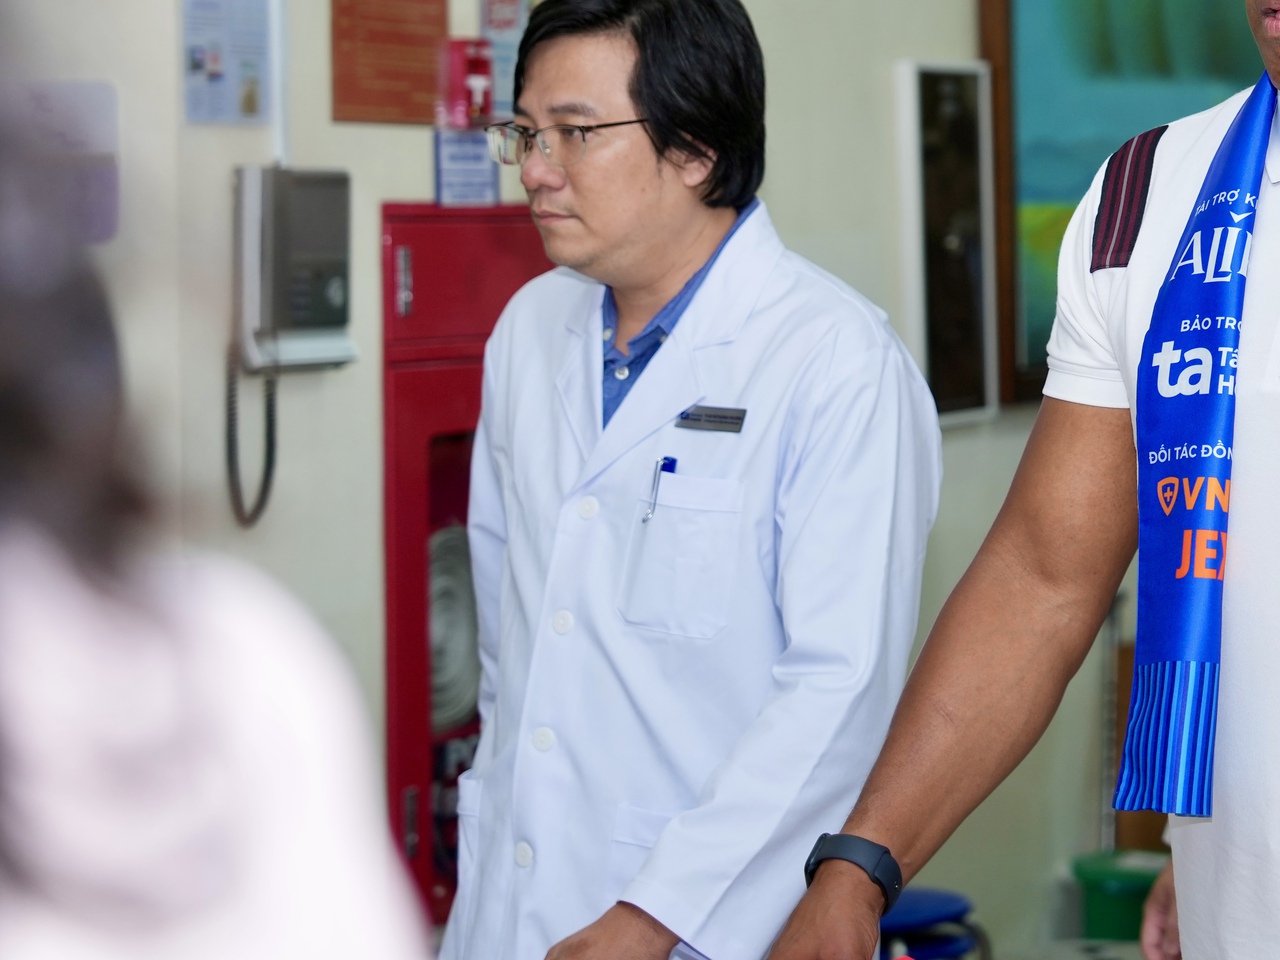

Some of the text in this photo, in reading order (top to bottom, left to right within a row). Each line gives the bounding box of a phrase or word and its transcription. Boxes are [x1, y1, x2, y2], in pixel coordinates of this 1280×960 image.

[1212, 189, 1240, 205] TRỢ
[1244, 193, 1258, 209] K
[1180, 314, 1212, 332] BẢO
[1151, 340, 1213, 398] ta
[1217, 374, 1237, 395] H
[1149, 444, 1171, 465] ĐỐI
[1174, 442, 1198, 460] TÁC
